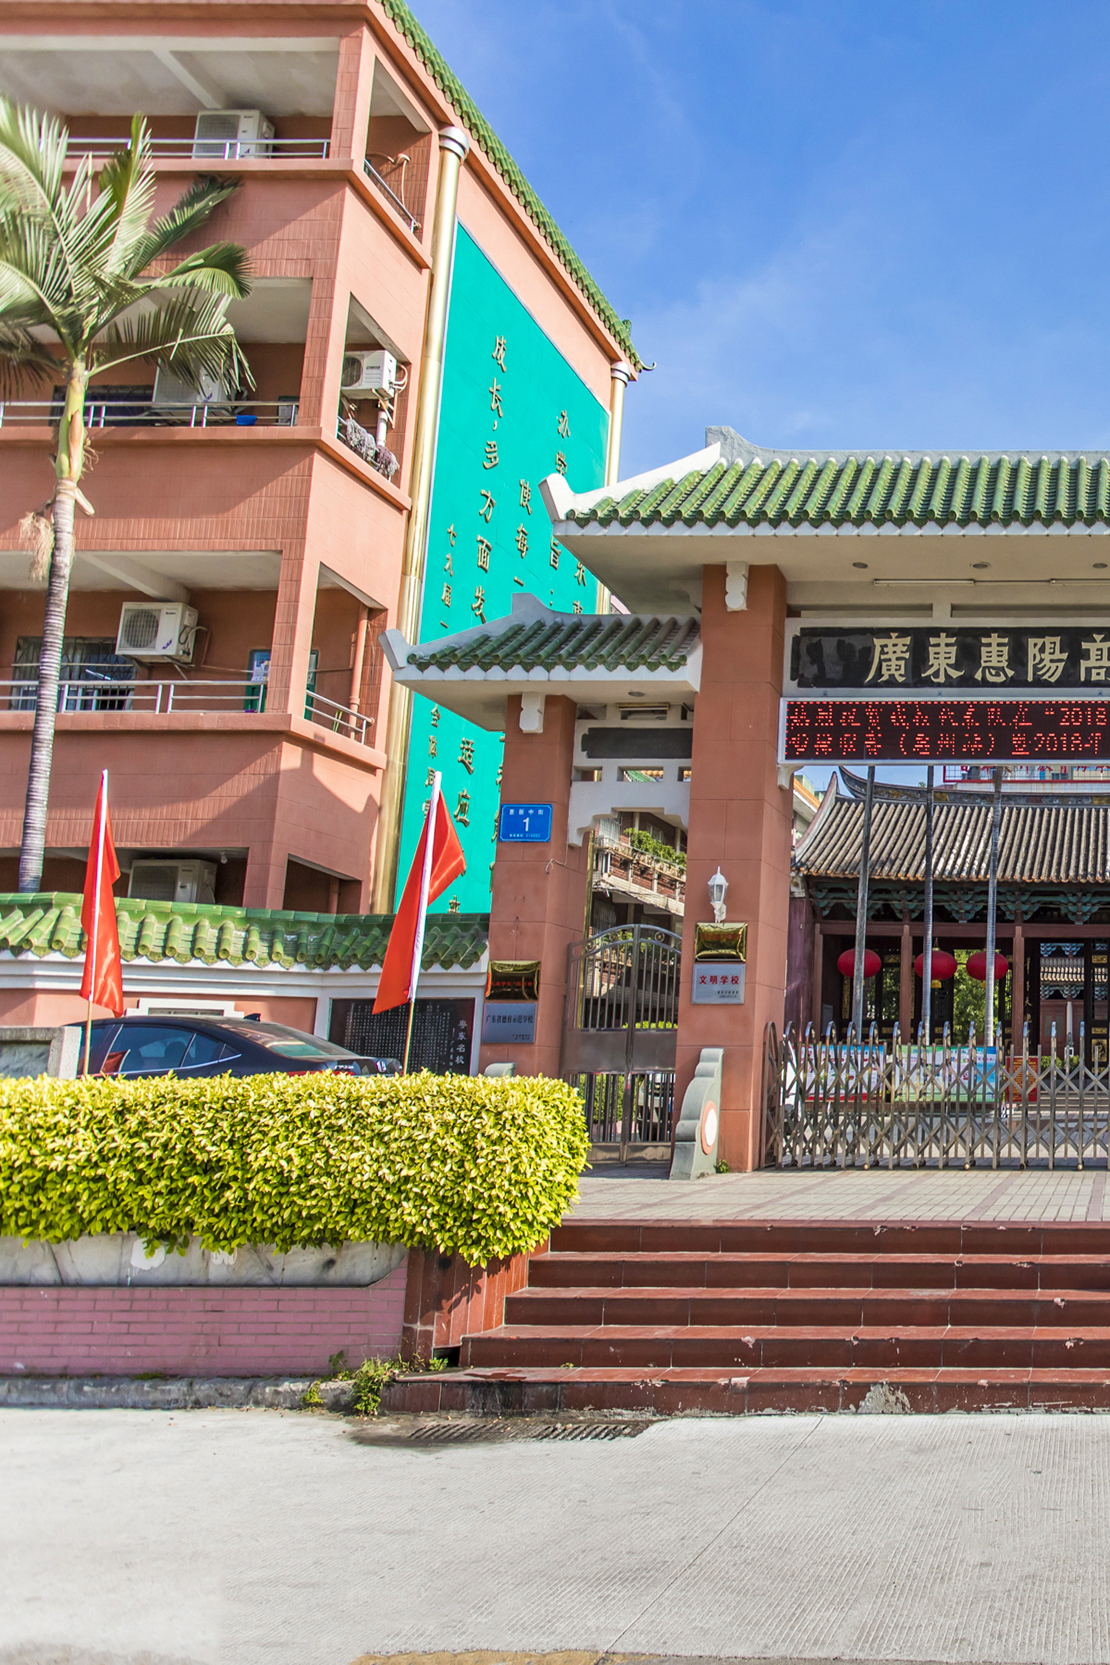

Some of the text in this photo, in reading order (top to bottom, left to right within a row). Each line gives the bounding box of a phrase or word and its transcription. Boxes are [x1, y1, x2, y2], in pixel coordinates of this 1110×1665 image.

[523, 816, 530, 832] 1
[698, 974, 740, 985] 文明学校
